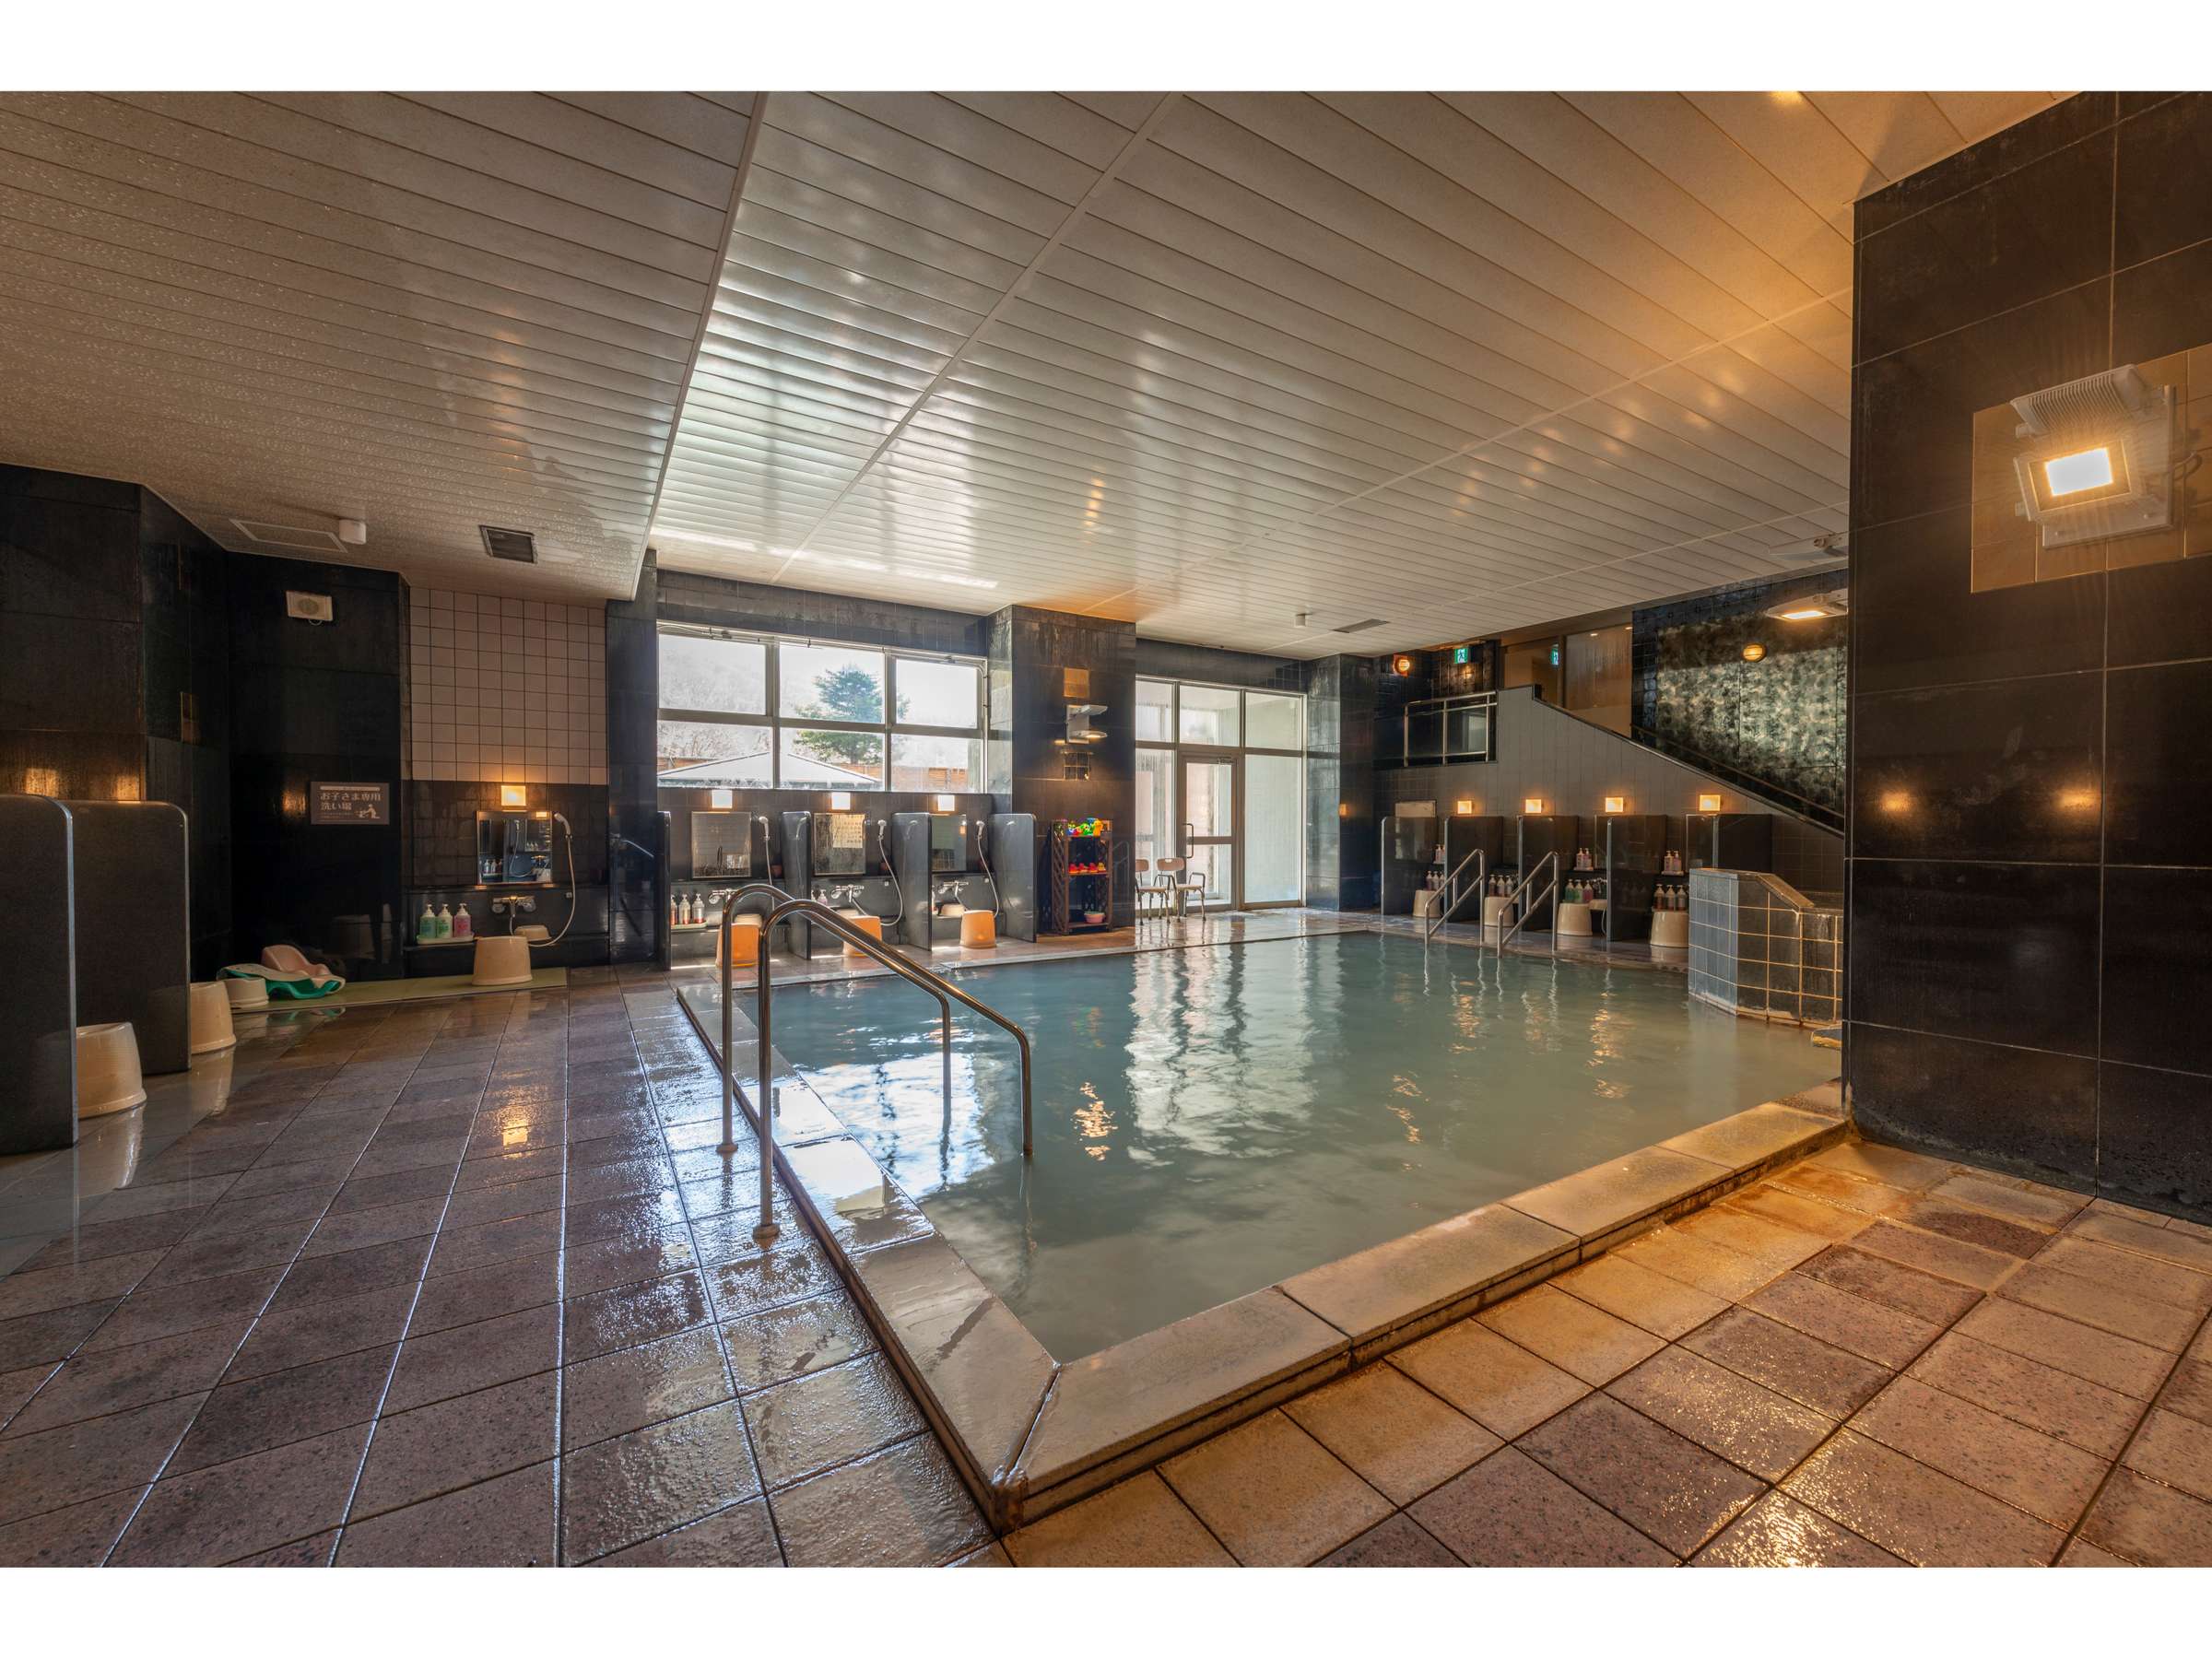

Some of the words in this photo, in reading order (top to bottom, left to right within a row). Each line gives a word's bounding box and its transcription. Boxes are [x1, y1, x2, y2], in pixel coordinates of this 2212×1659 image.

[320, 793, 382, 801] お子さま専用
[321, 802, 352, 811] 洗い場
